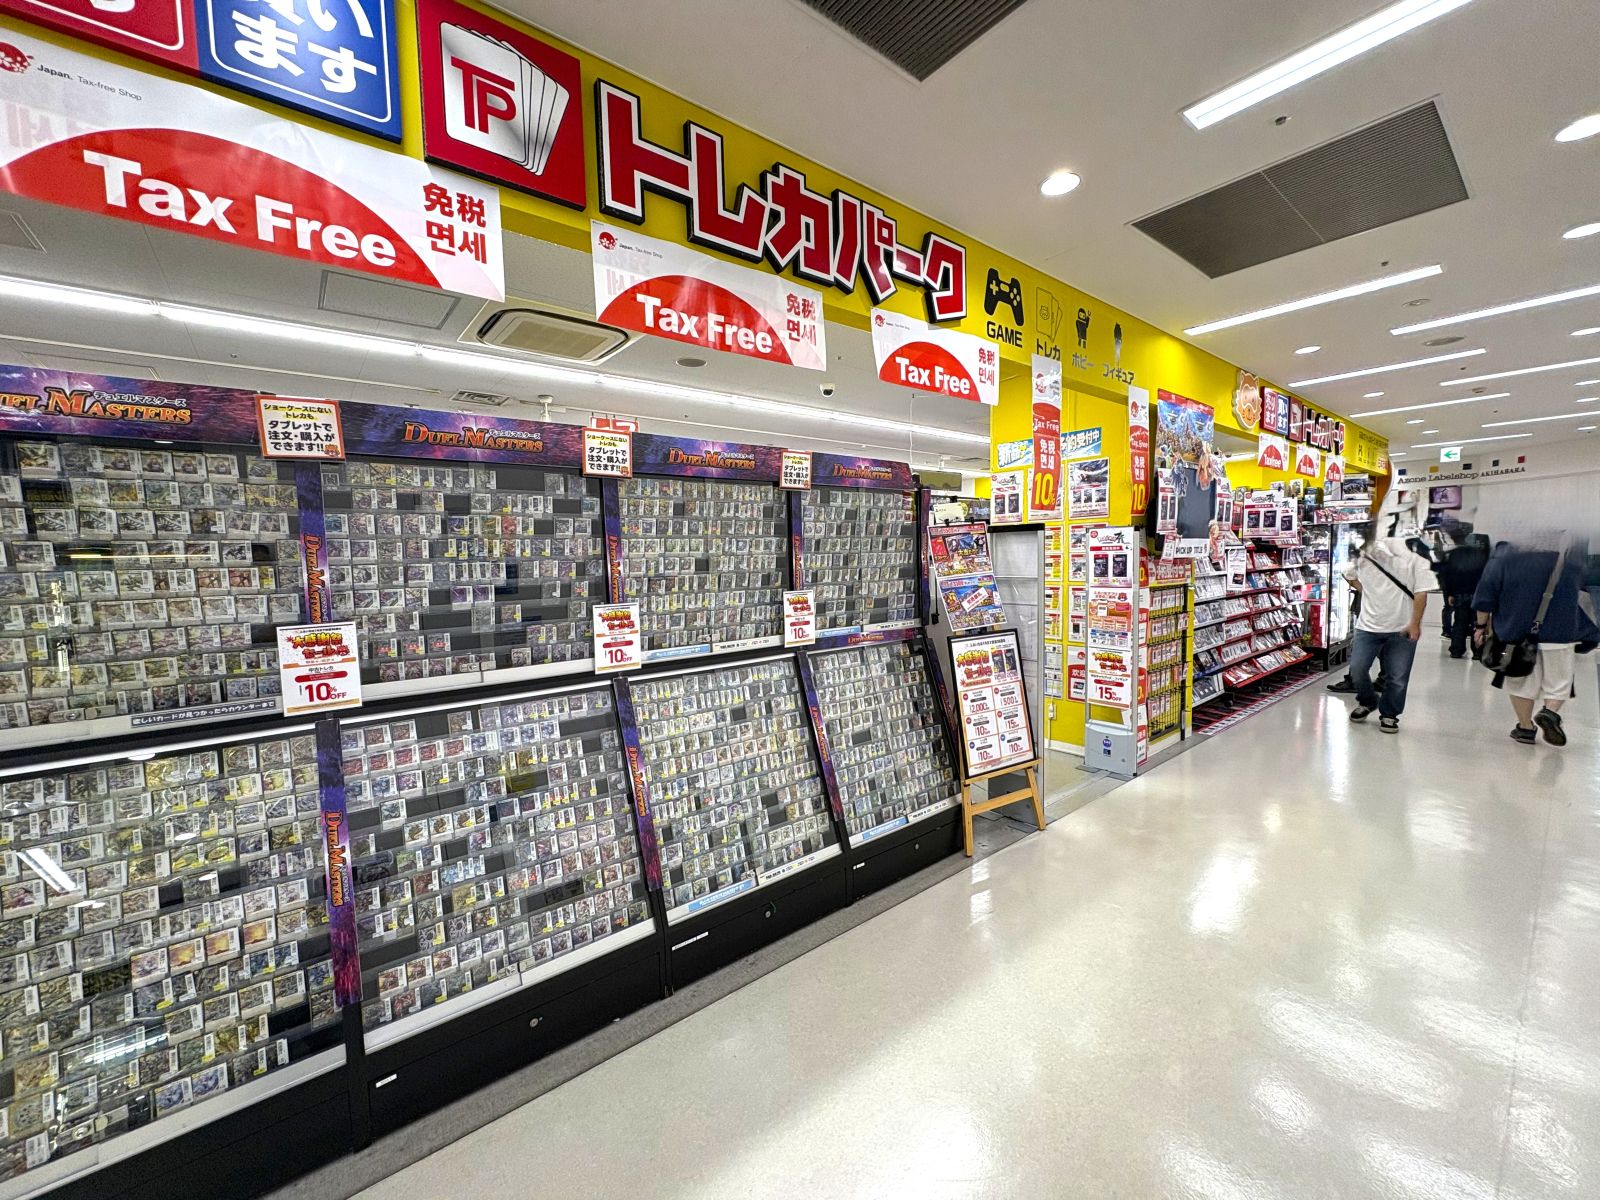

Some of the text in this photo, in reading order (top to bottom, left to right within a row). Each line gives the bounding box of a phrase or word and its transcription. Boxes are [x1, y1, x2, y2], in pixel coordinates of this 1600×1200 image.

[231, 10, 378, 94] ます
[37, 64, 142, 101] Japan. Tax-free Shop
[450, 56, 517, 136] TP
[82, 149, 397, 267] Tax Free
[422, 182, 487, 228] 免税
[594, 78, 967, 323] トレカパーク
[426, 220, 488, 265] 면세
[786, 292, 816, 321] 免税
[636, 293, 773, 354] Tax Free
[786, 318, 817, 347] 면세
[986, 321, 1023, 348] GAME
[978, 347, 996, 367] 免税
[1036, 338, 1061, 362] トレカ
[1071, 353, 1095, 371] ホビー
[895, 356, 971, 395] Tax Free
[44, 386, 192, 425] MASTERS
[263, 403, 332, 414] ショーケースにない
[285, 412, 315, 420] トレカも
[268, 420, 333, 432] タブレットで
[268, 430, 335, 442] 注文・購入が
[404, 421, 544, 453] DUEL MASTERS
[270, 441, 324, 452] できます!!
[587, 454, 628, 465] 注文・購入が
[589, 446, 627, 457] タブレットで
[1428, 472, 1479, 482] Labelshop
[330, 691, 347, 700] OFF
[132, 701, 275, 726] 欲しいカードが見つかったらカウンターまで
